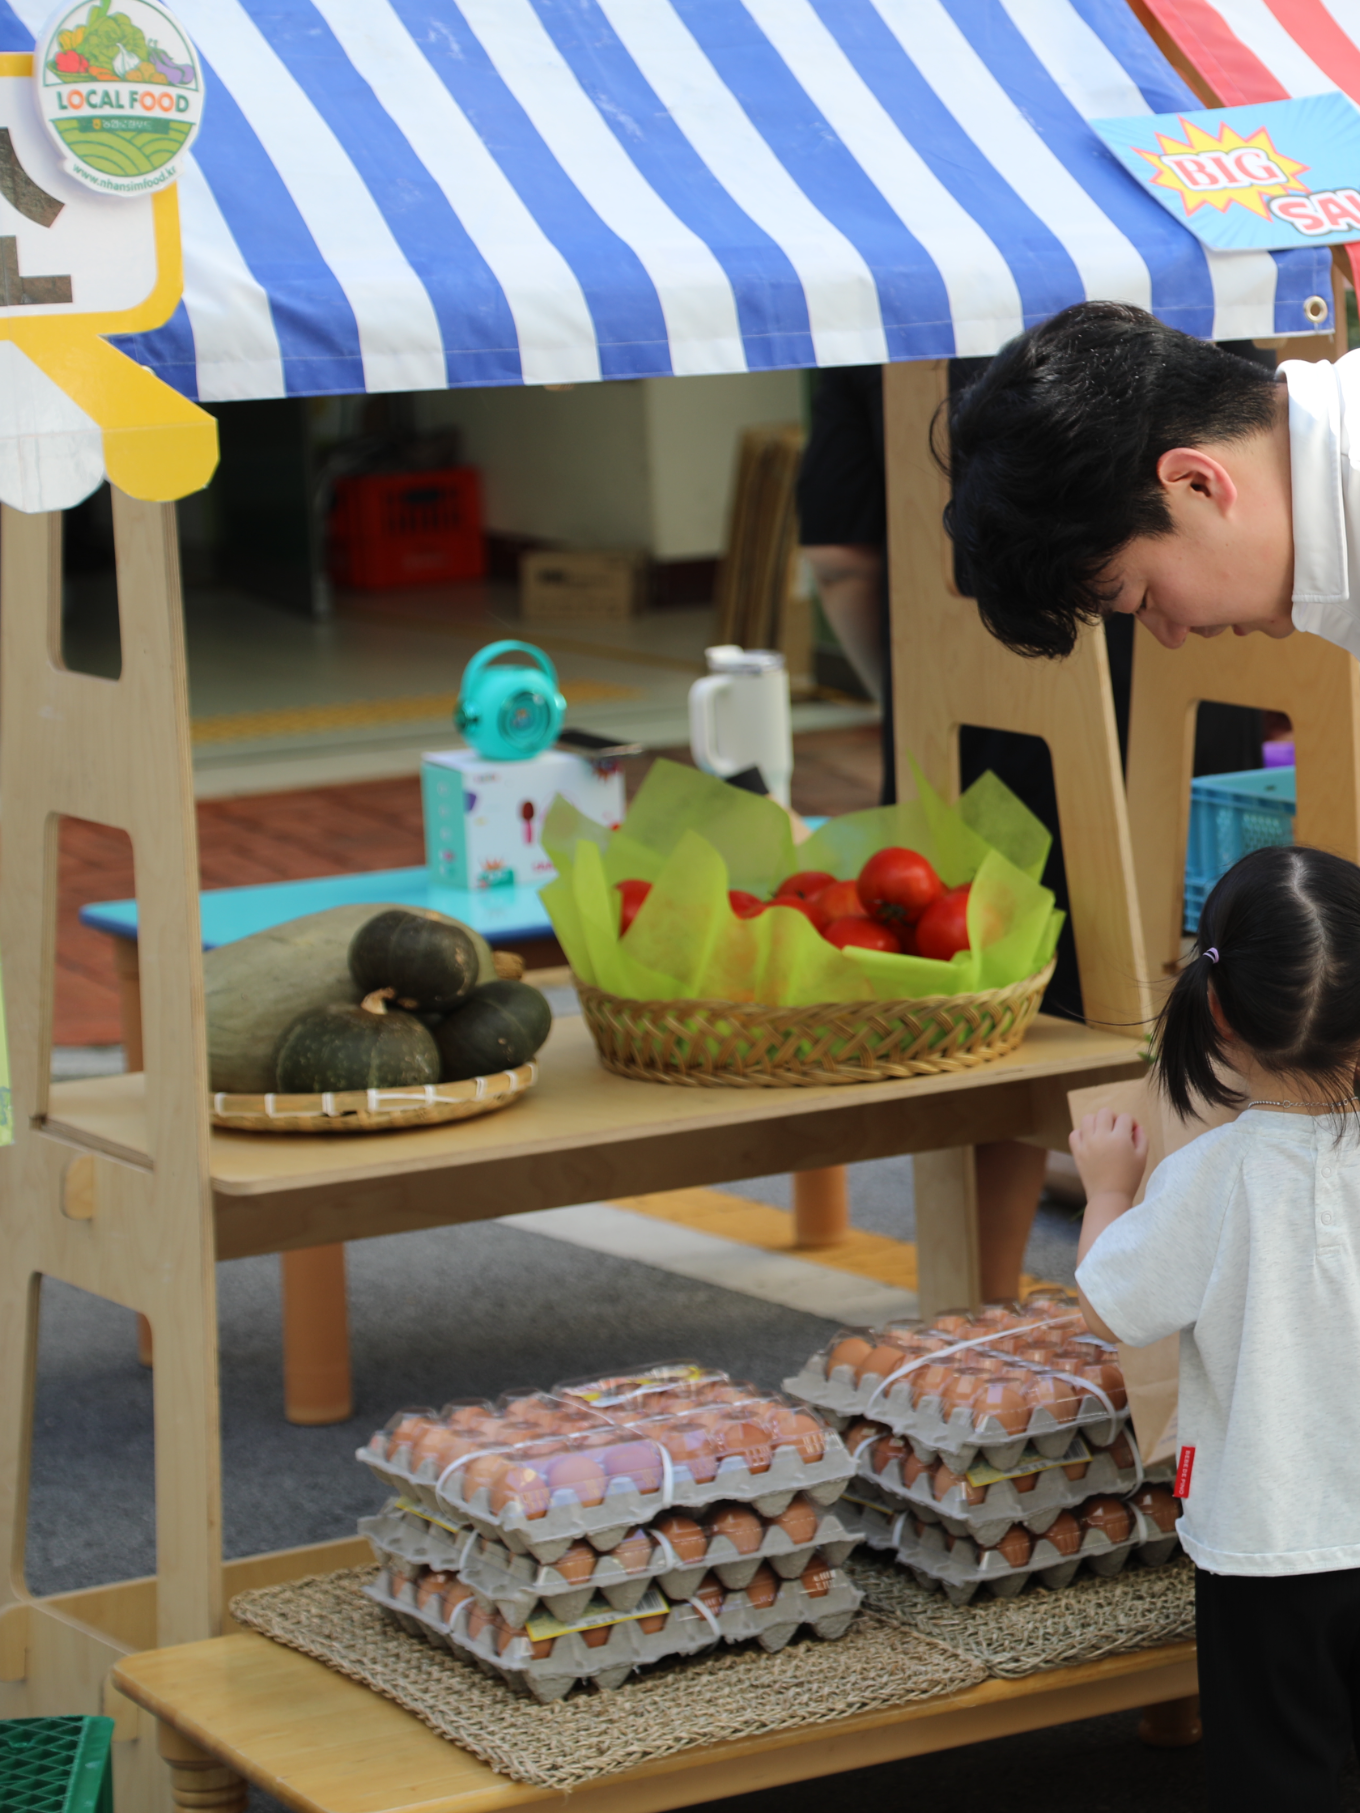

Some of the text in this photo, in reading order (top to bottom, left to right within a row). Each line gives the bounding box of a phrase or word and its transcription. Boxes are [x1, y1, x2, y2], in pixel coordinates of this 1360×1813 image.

[56, 89, 190, 113] LOCAL FOOD
[72, 164, 177, 192] www.nhansimfood.kr
[1169, 152, 1280, 187] BIG
